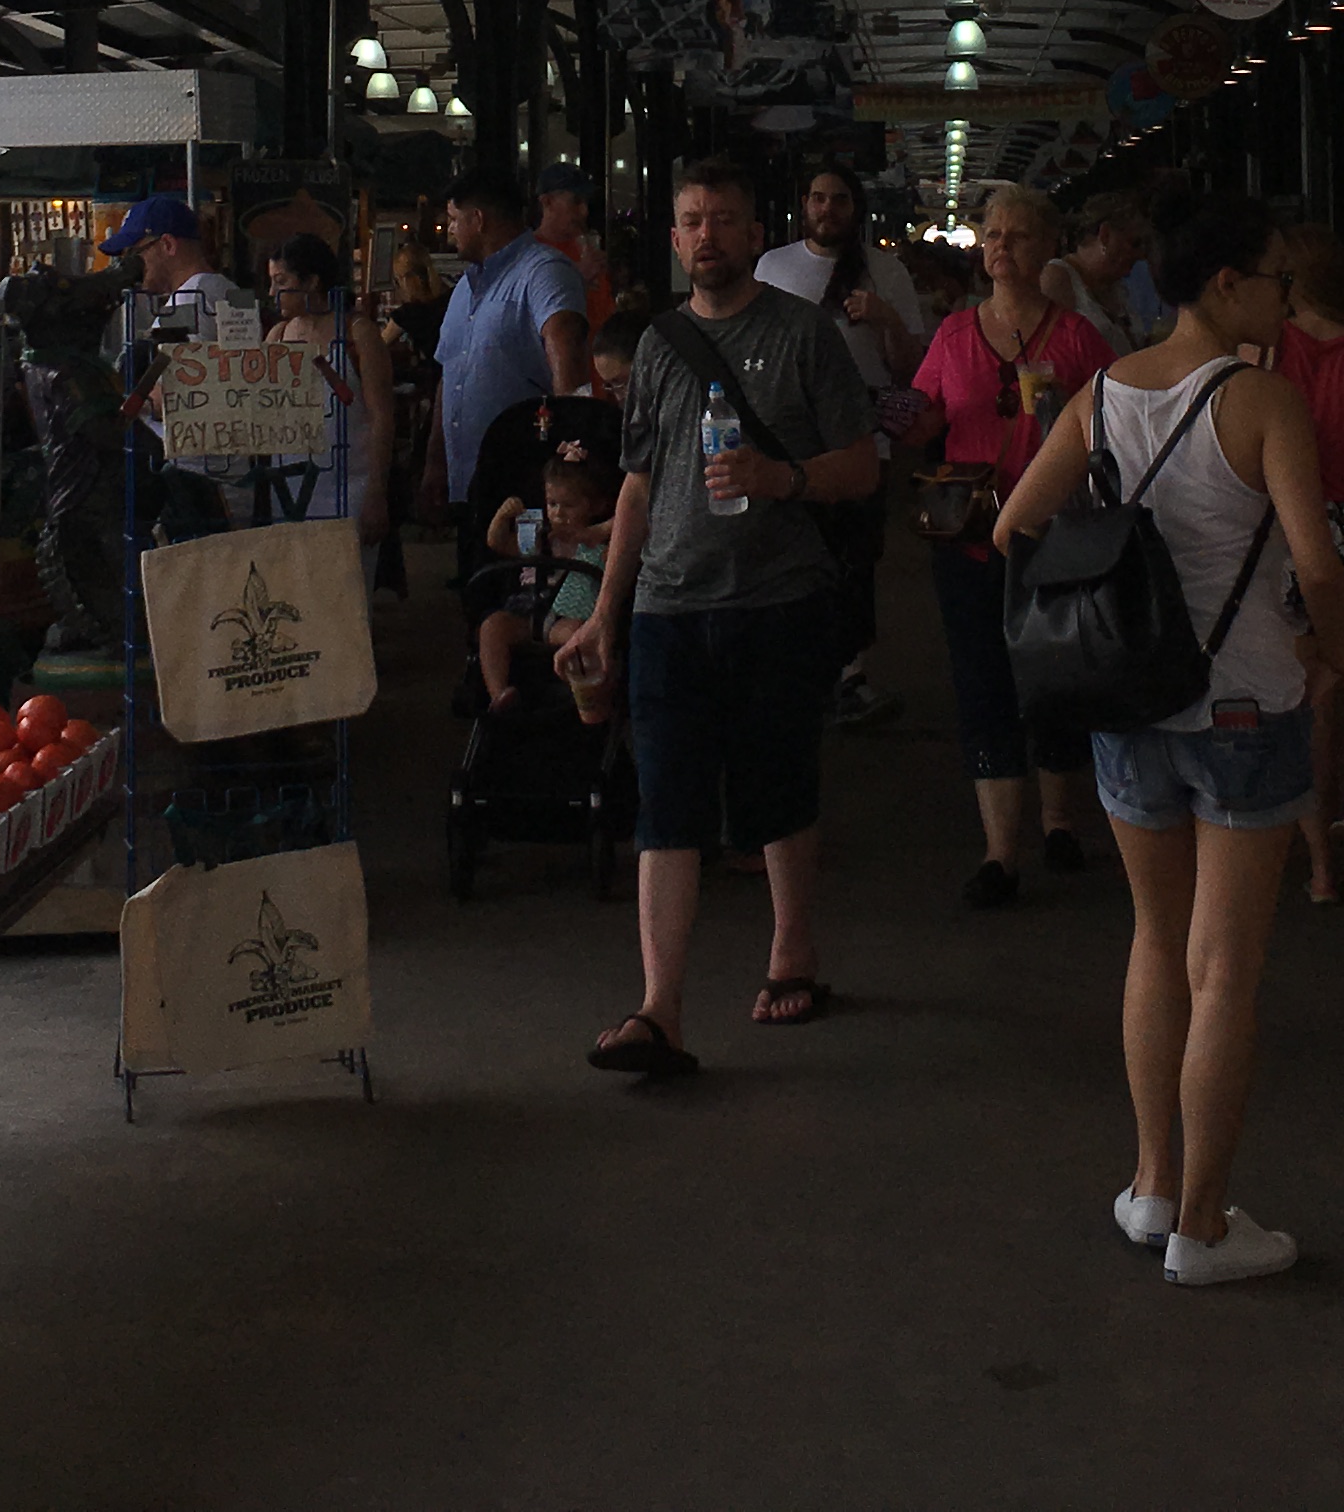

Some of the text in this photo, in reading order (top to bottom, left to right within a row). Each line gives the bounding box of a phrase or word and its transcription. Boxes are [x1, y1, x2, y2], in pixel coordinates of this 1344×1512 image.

[233, 167, 290, 184] FROZEN
[172, 343, 304, 388] STOP!
[164, 391, 209, 415] END
[225, 389, 250, 408] OF
[170, 420, 207, 453] PAY
[213, 419, 296, 449] BEHIND
[225, 663, 311, 692] PRODUCE
[245, 993, 334, 1023] PRODUCE
